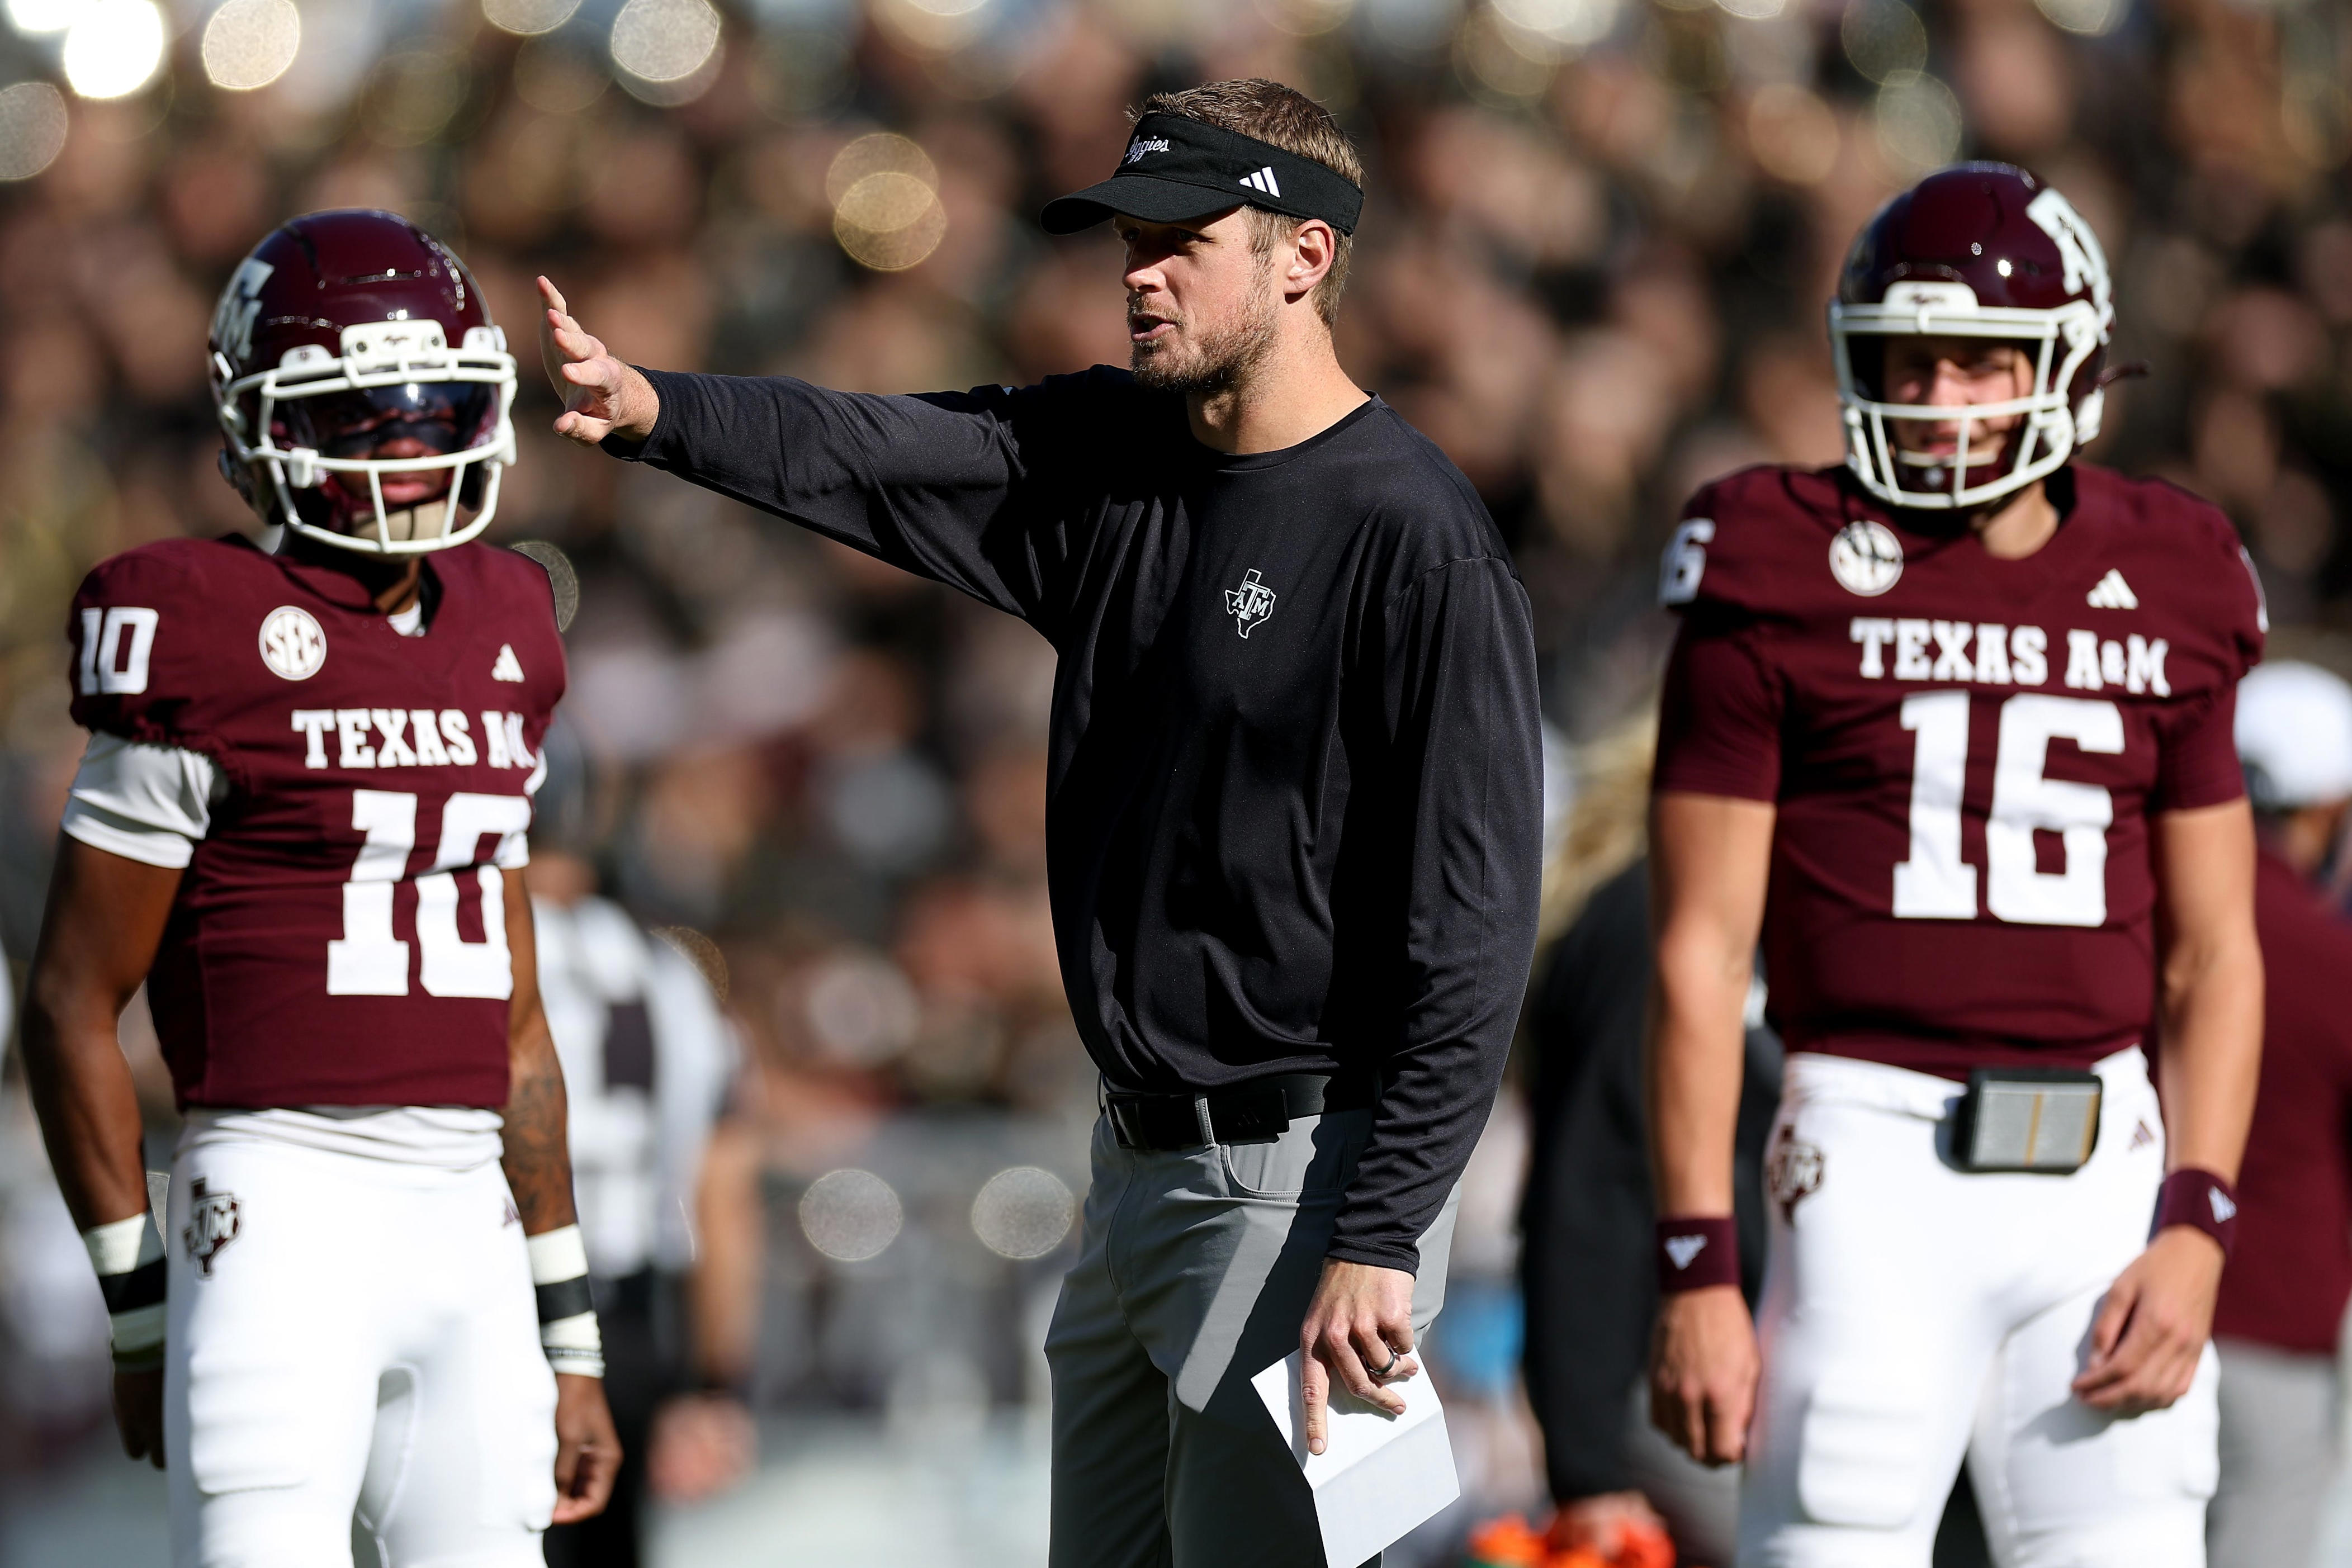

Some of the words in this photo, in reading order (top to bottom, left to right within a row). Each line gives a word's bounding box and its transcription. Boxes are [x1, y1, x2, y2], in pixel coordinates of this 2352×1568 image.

[1125, 135, 1170, 164] Aggies
[79, 606, 159, 695] 10
[265, 612, 321, 674] SEC
[1849, 616, 2048, 686] TEXAS
[2065, 628, 2172, 698] A&M
[291, 708, 477, 770] TEXAS
[1892, 689, 2125, 927] 16
[326, 789, 532, 999] 10
